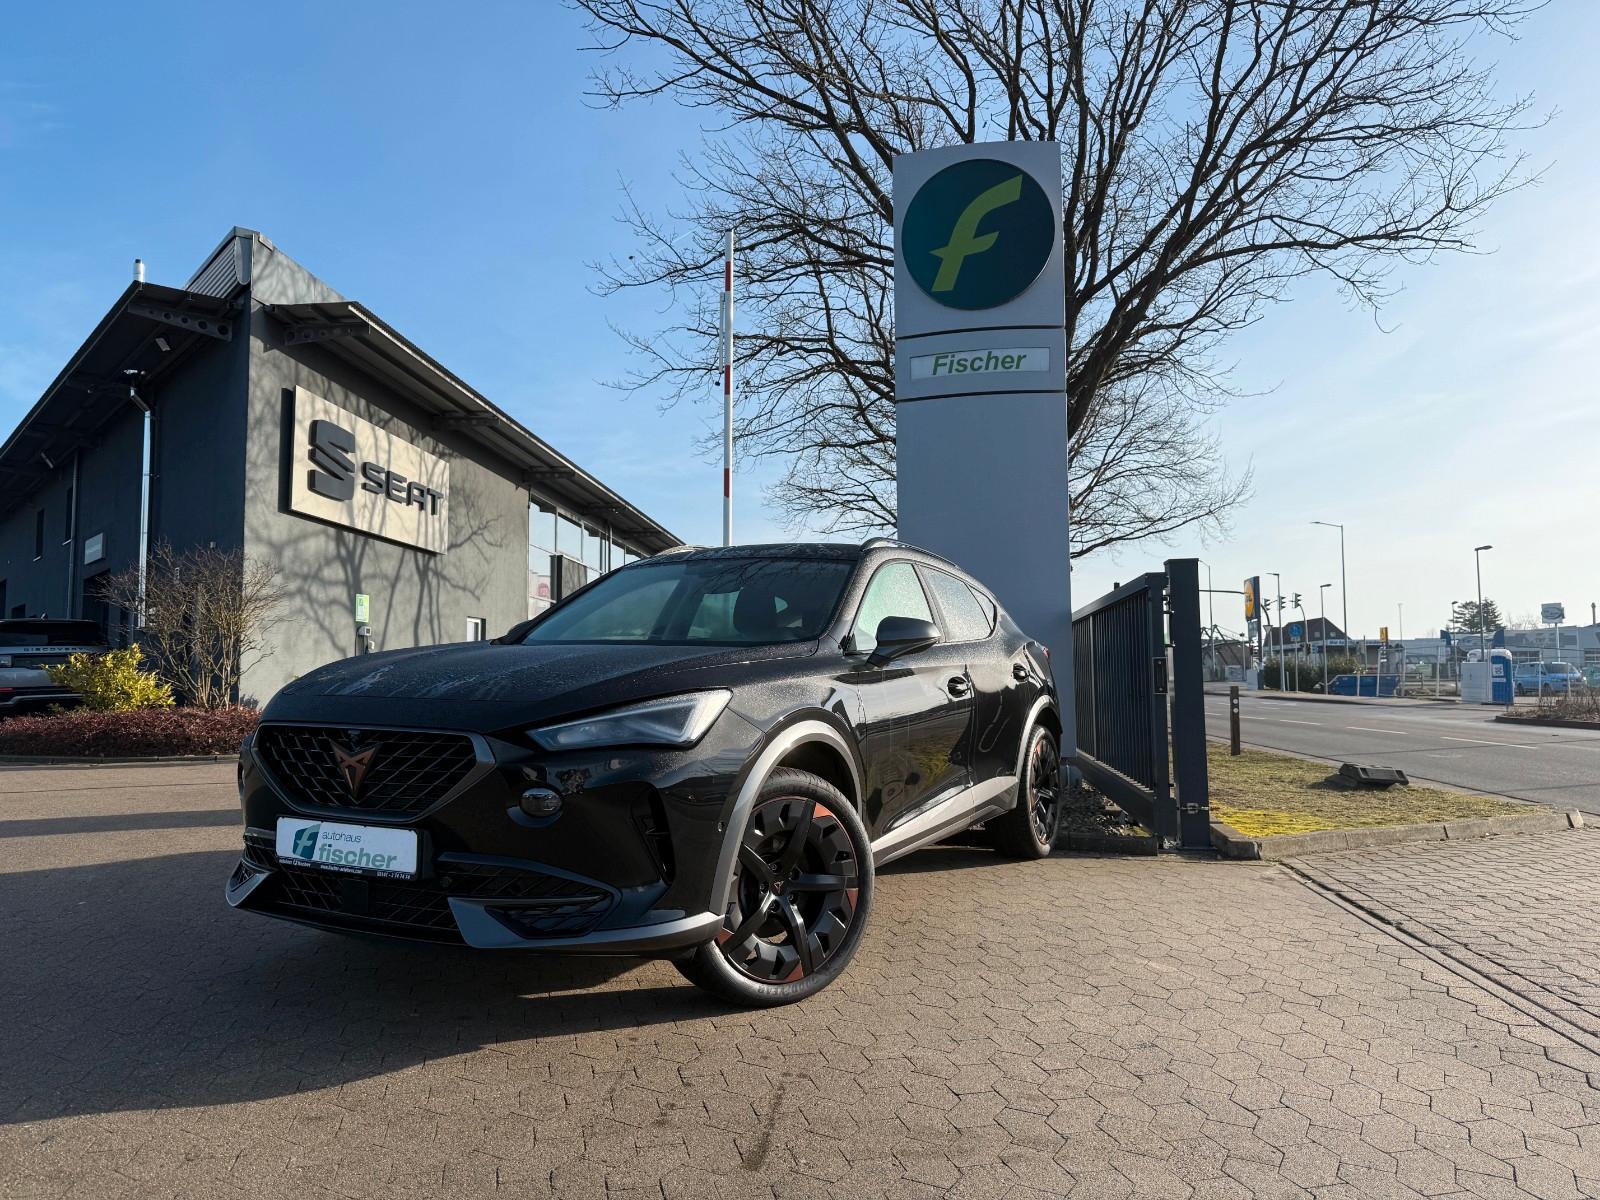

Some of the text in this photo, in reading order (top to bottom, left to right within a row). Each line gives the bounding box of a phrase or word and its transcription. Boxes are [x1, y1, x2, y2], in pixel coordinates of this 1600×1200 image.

[932, 351, 1027, 376] Fischer
[361, 461, 443, 516] SEAT
[321, 831, 362, 843] autohaus
[318, 843, 398, 869] fischer
